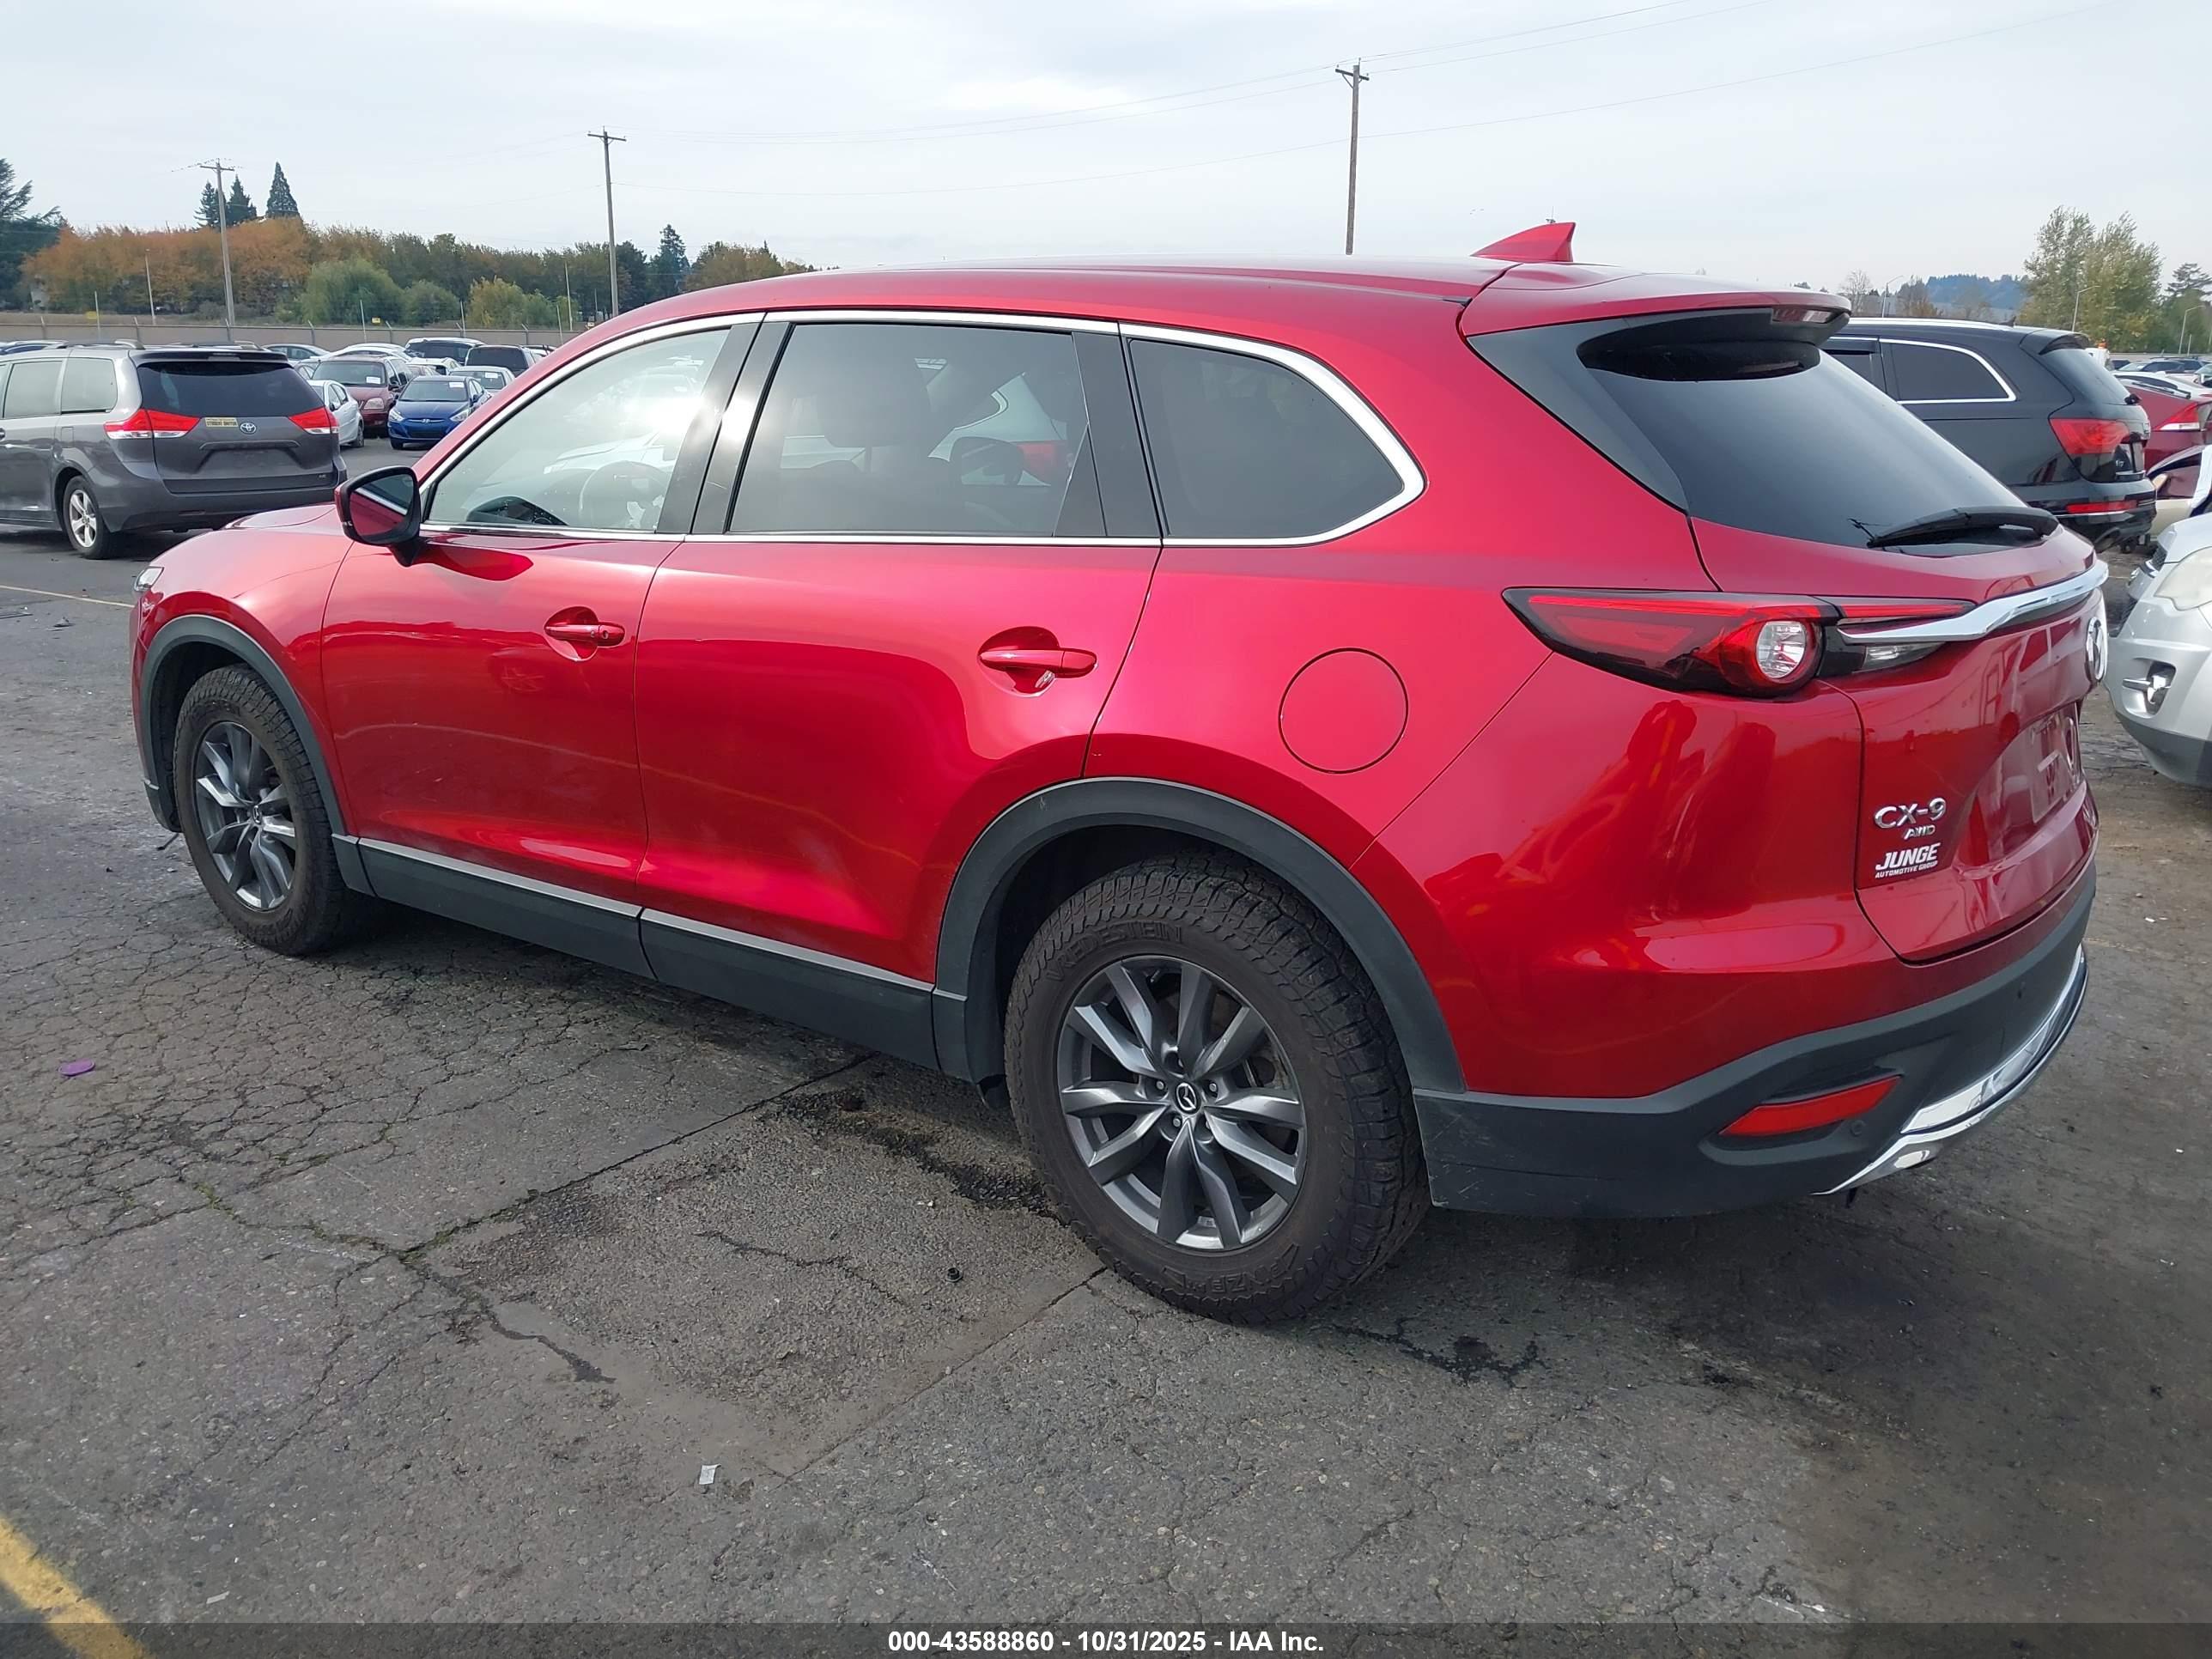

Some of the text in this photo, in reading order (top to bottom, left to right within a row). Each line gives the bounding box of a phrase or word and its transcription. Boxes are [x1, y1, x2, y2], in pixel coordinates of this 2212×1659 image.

[1875, 798, 1946, 829] CX-9
[1904, 824, 1936, 840] AWD
[1875, 842, 1941, 870] JUNGE
[1875, 860, 1938, 878] AUTOMOTIVE GROUP
